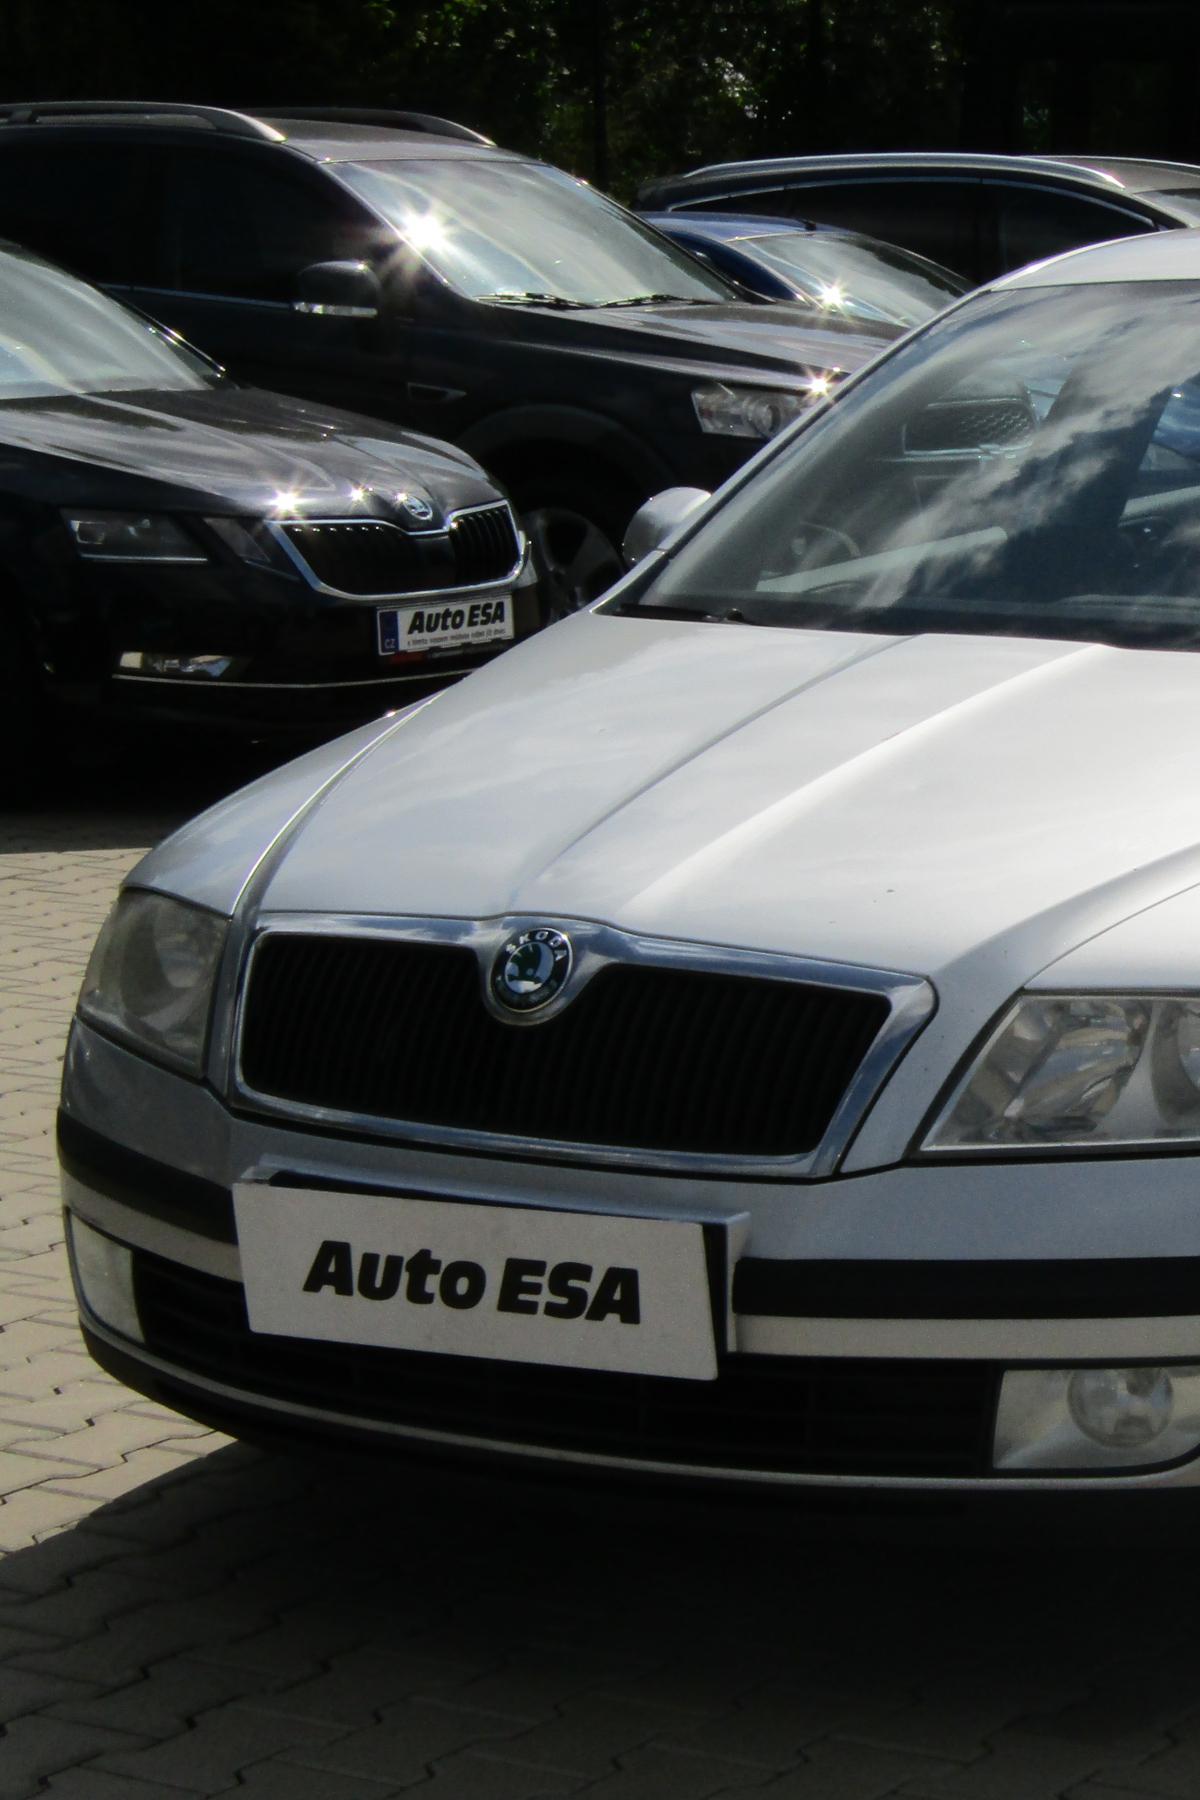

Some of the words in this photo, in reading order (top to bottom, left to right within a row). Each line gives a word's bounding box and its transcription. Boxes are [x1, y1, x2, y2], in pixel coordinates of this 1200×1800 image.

[407, 608, 464, 635] Auto
[467, 601, 505, 627] ESA
[303, 1240, 486, 1310] Auto
[497, 1257, 641, 1325] ESA
